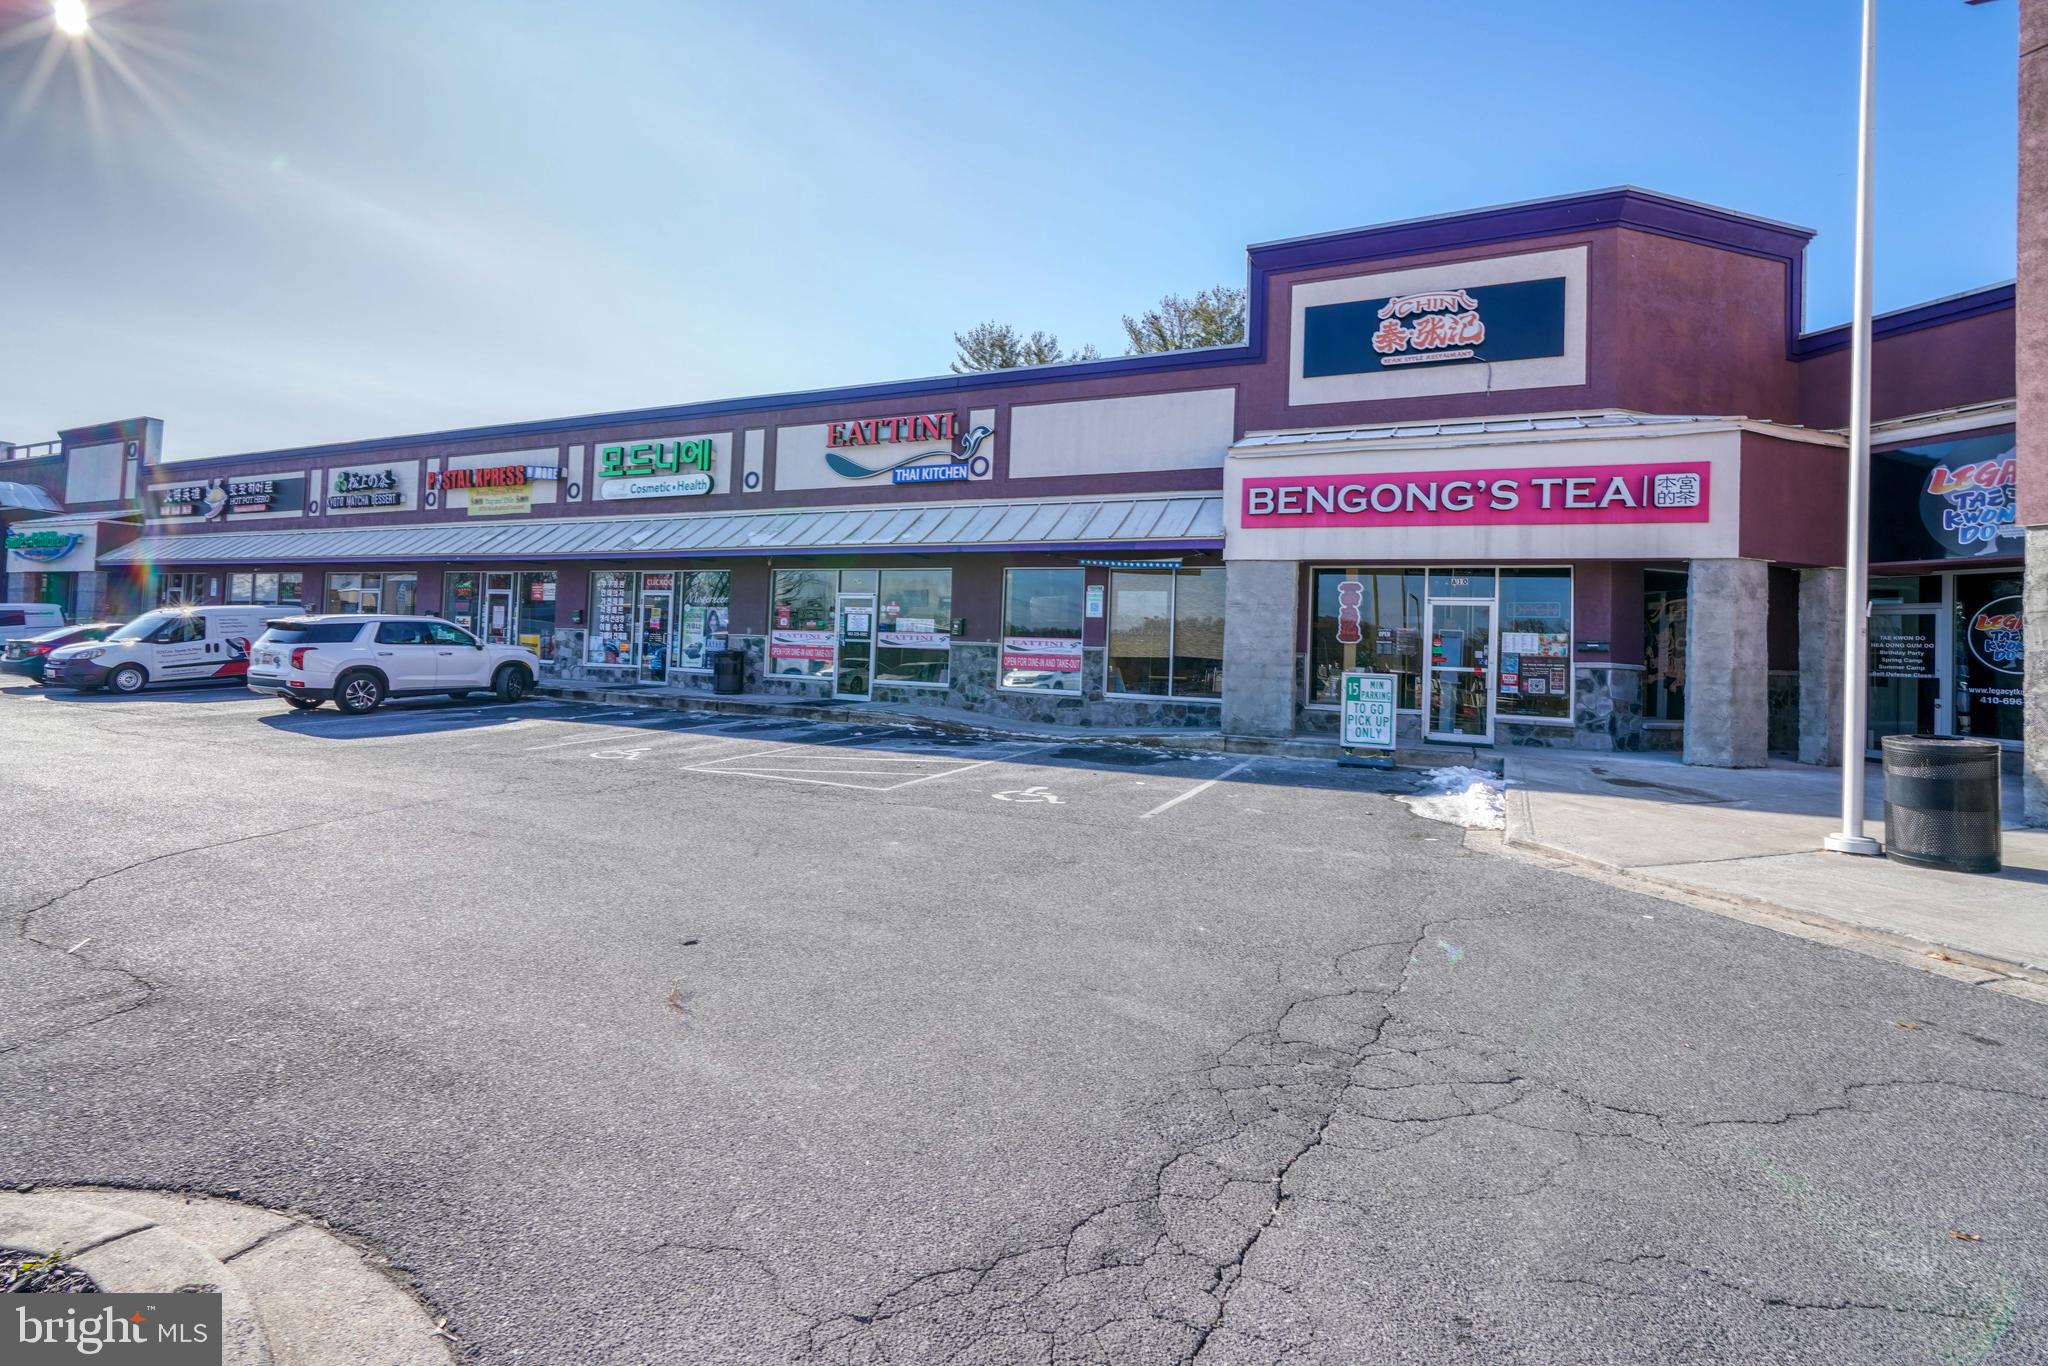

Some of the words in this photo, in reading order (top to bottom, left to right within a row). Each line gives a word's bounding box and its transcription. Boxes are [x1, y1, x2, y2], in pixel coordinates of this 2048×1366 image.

[826, 412, 957, 448] EATTINI
[598, 439, 712, 477] 모드니에
[474, 465, 525, 487] XPRESS
[895, 468, 919, 481] THAI
[922, 466, 967, 480] KITCHEN
[630, 481, 670, 494] Cosmetic
[677, 478, 707, 491] Health
[1248, 479, 1519, 515] BENGONG'S
[1531, 476, 1637, 509] TEA
[1952, 488, 2005, 511] TAE
[1943, 503, 2016, 530] KWON
[1958, 524, 1998, 544] DO
[647, 578, 673, 586] CUCKOO
[1013, 639, 1064, 647] EATTINI
[1004, 656, 1017, 666] OPEN
[1017, 657, 1027, 666] FOR
[1045, 658, 1056, 667] AND
[1057, 658, 1081, 669] TAKE-OUT
[1348, 682, 1359, 696] 15
[1370, 681, 1384, 689] MIN
[1361, 690, 1391, 700] PARKING
[1354, 702, 1365, 713] TO
[1370, 703, 1384, 715] GO
[1348, 714, 1371, 726] PICK
[1376, 716, 1389, 727] UP
[1355, 727, 1382, 738] ONLY
